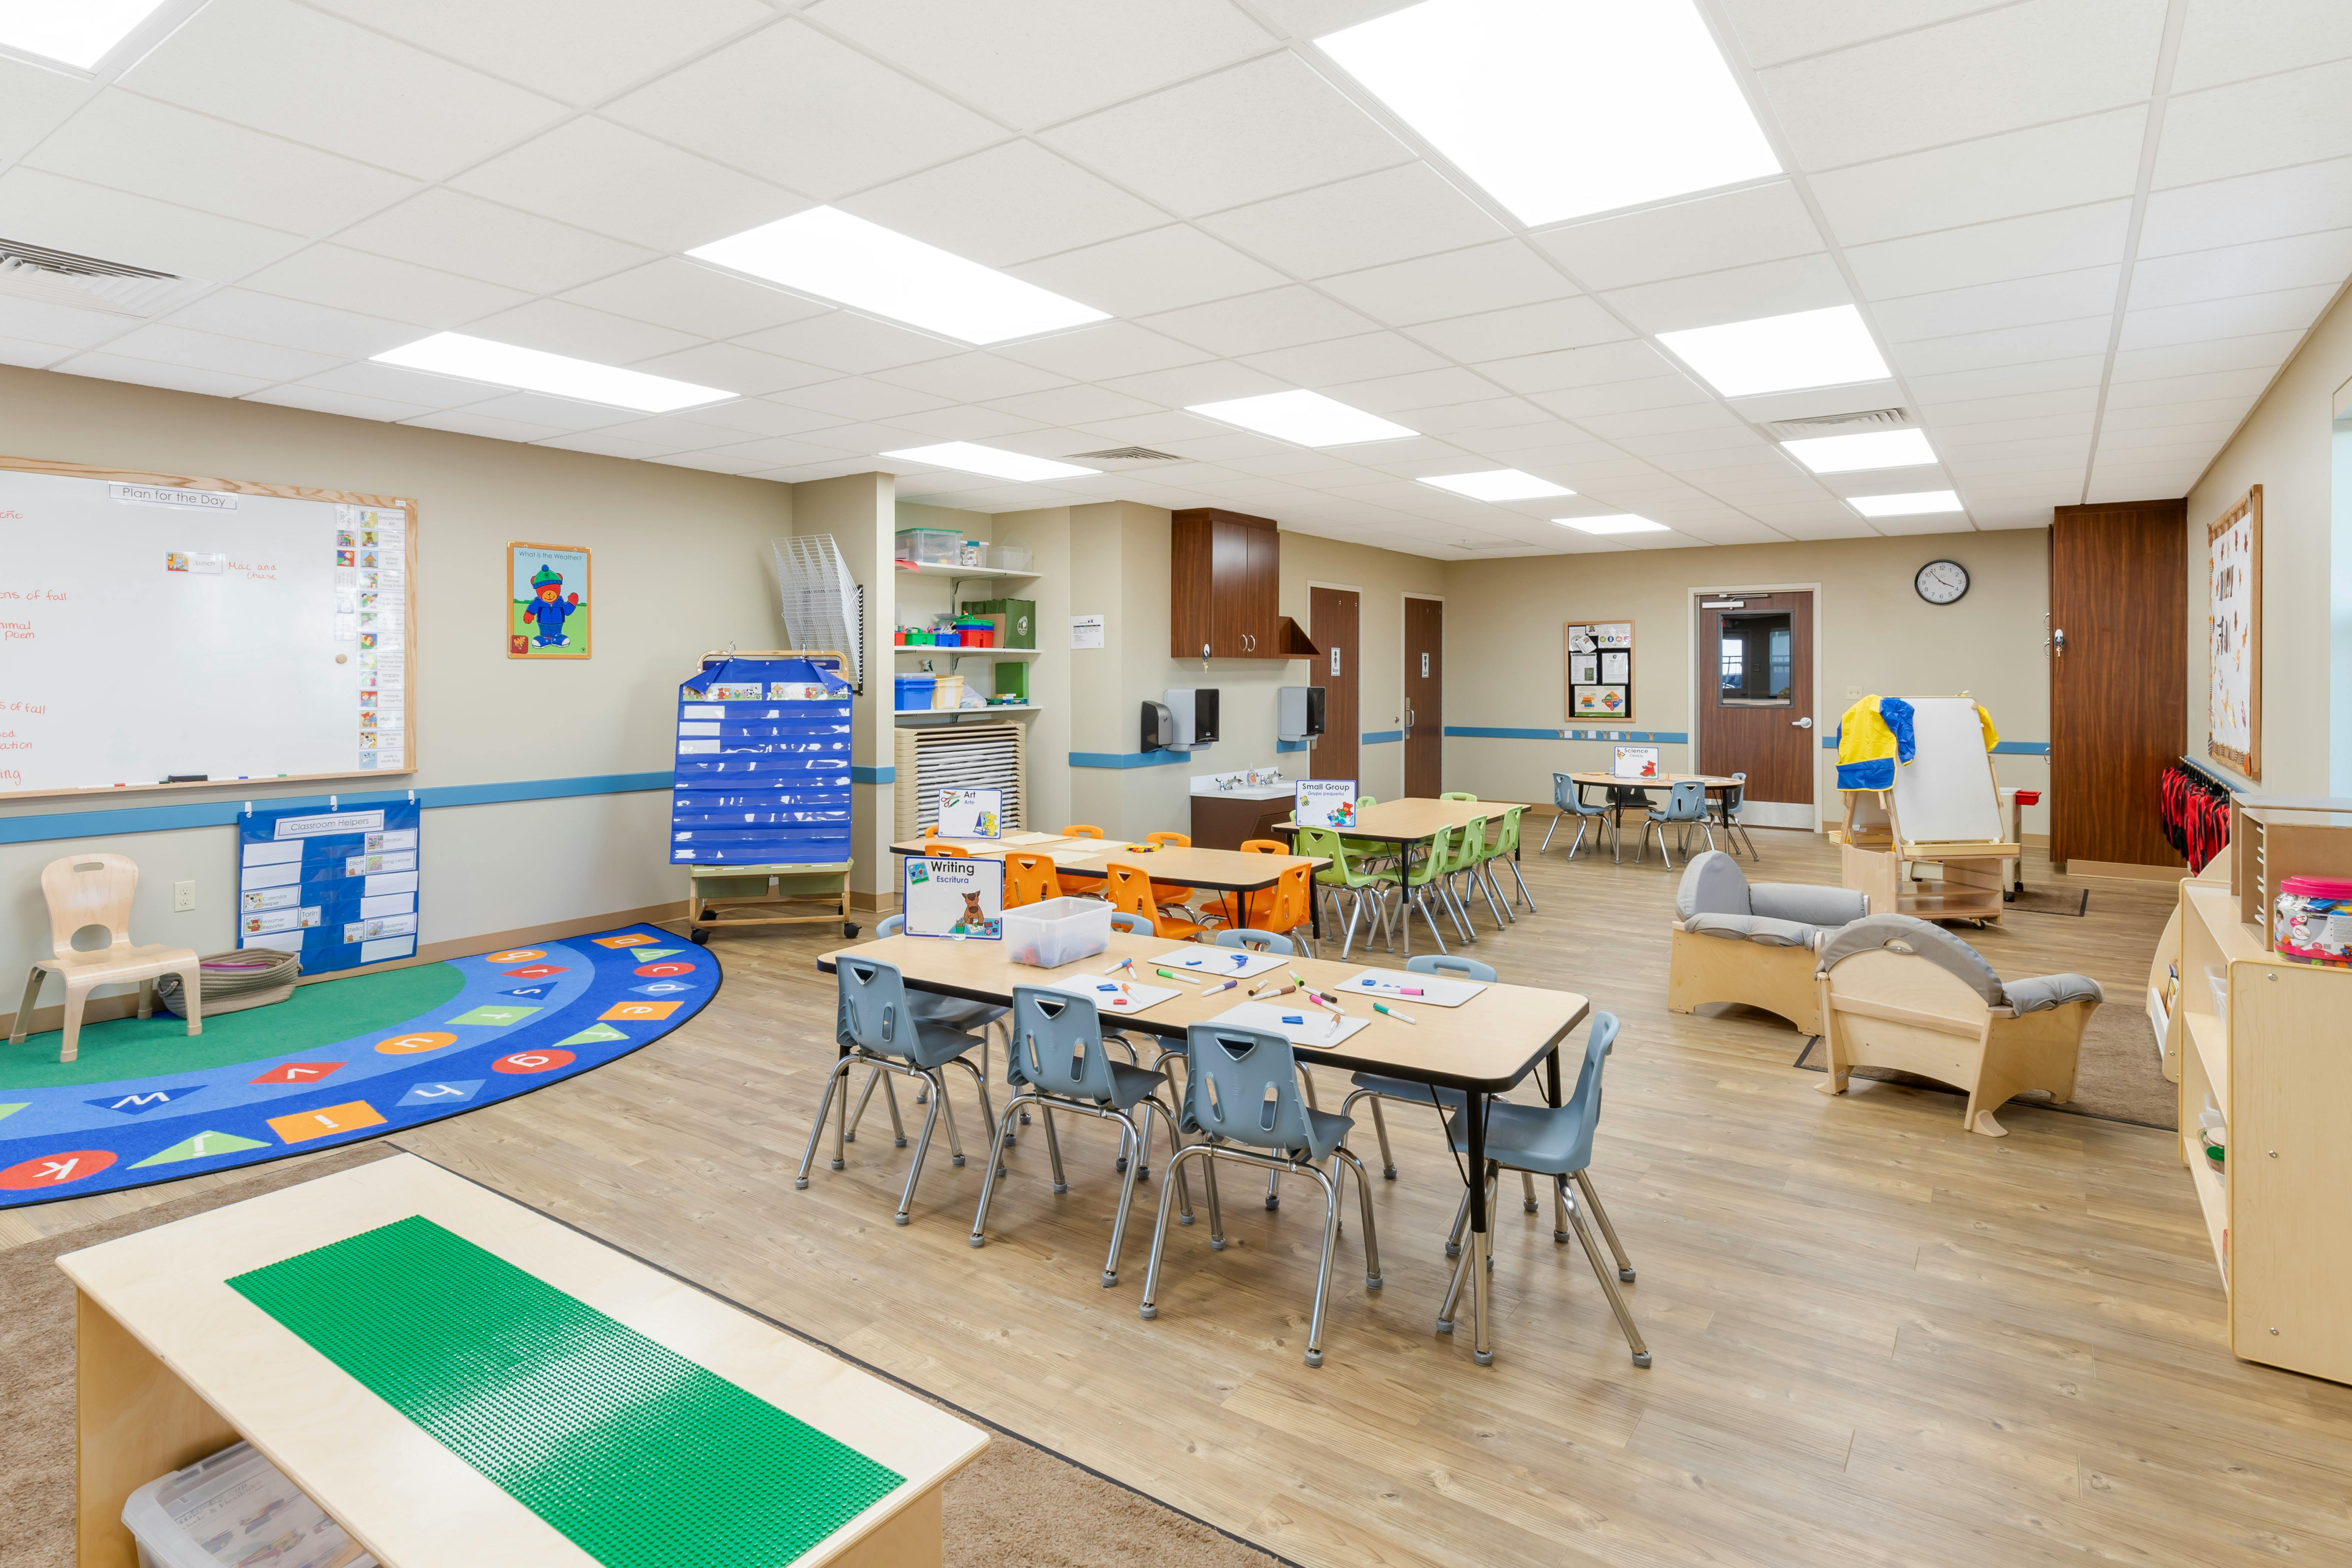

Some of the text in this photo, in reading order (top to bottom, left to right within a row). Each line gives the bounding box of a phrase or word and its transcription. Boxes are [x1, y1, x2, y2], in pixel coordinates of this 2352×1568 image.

[123, 487, 225, 507] Plan for the Day
[228, 562, 251, 571] Mac
[26, 590, 41, 600] of
[46, 590, 67, 601] fall
[11, 701, 23, 711] of
[25, 703, 46, 714] fall
[291, 817, 369, 831] Classroom Helpers
[931, 861, 974, 876] Writing
[936, 876, 969, 884] Escritura
[496, 951, 536, 961] q
[638, 949, 665, 958] b
[622, 1006, 653, 1014] e
[480, 1012, 513, 1020] t
[584, 1031, 619, 1039] f
[507, 1054, 549, 1067] g
[413, 1084, 465, 1096] h
[314, 1115, 339, 1129] i
[192, 1133, 213, 1156] j
